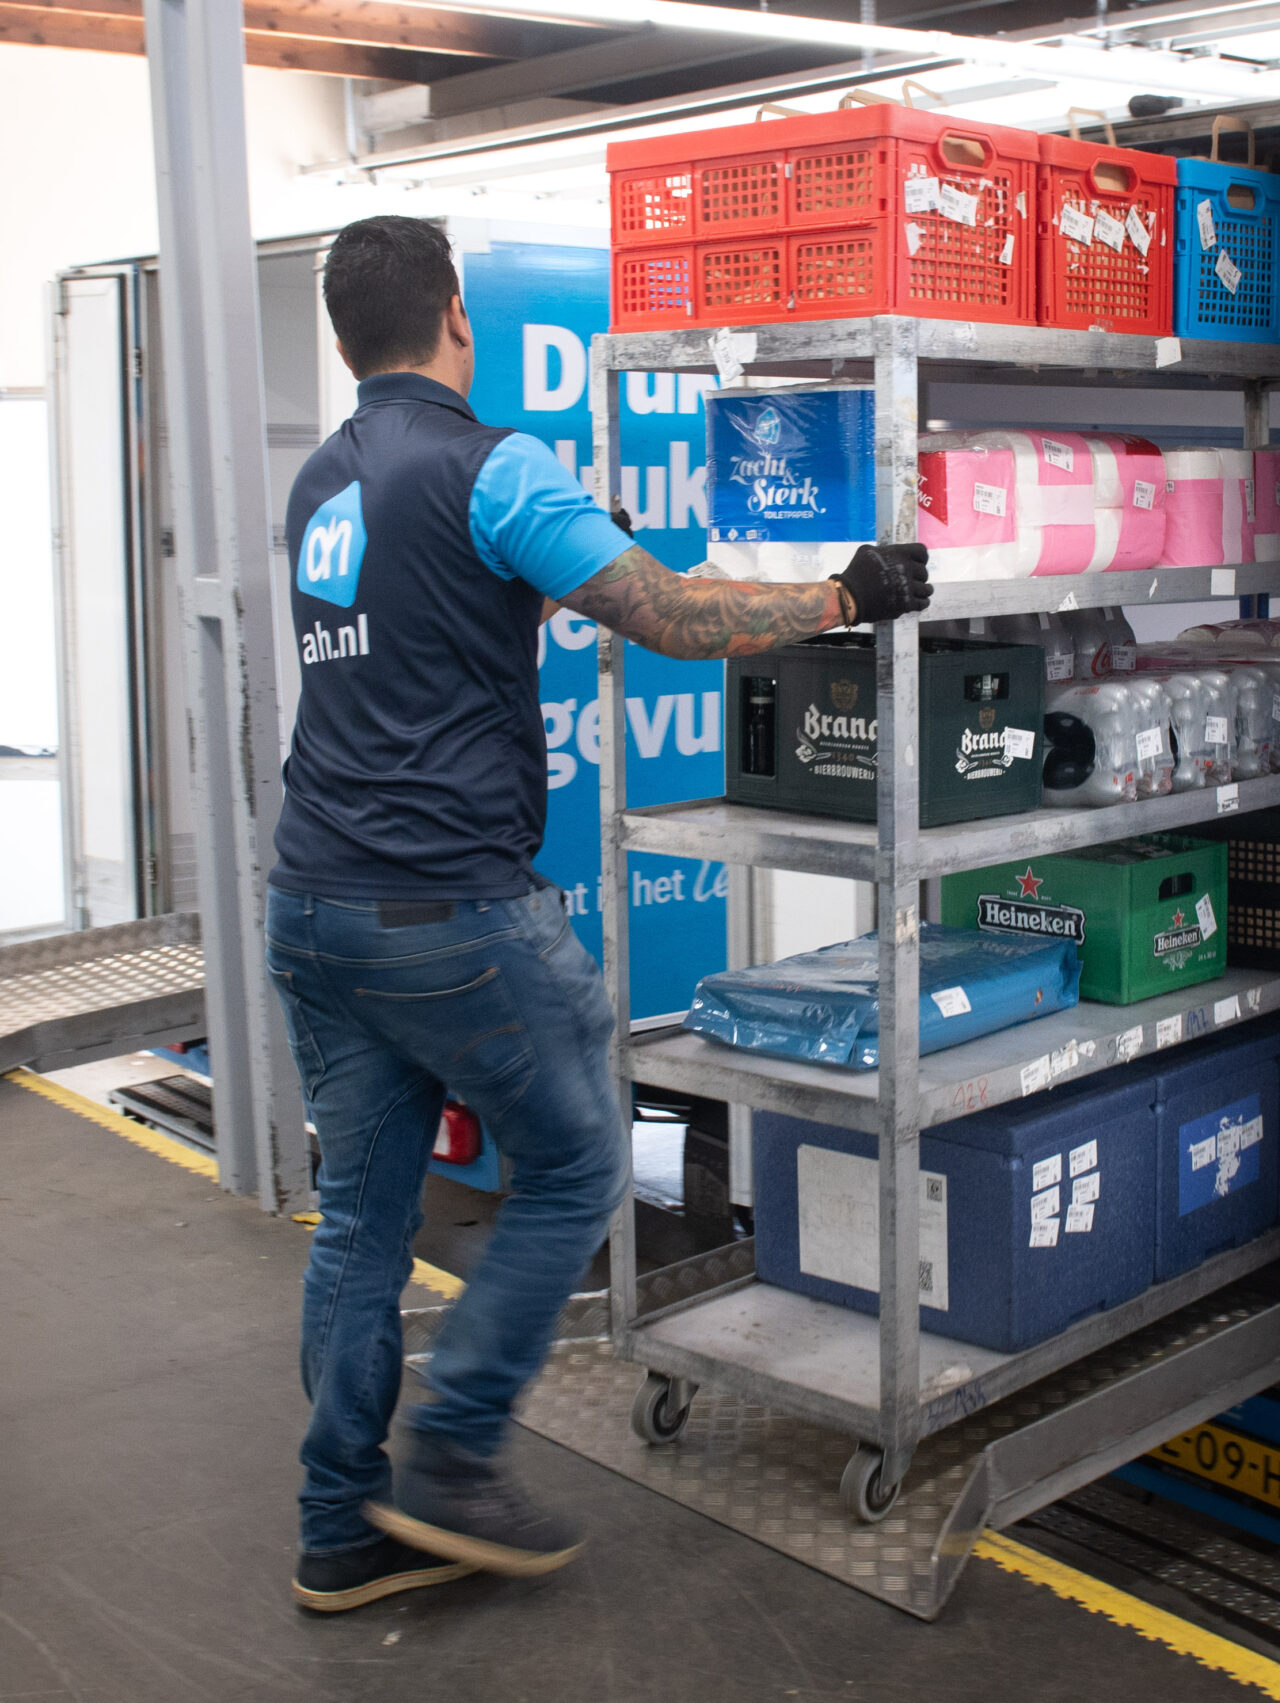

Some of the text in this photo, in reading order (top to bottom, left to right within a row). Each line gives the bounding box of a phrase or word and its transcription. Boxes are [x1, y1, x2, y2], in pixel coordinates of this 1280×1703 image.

[747, 477, 827, 513] Sterk
[763, 510, 814, 519] TOILETPAPIER
[302, 613, 370, 665] ah.nl
[814, 764, 875, 780] BIERBROUWERIJ
[632, 869, 685, 907] het
[985, 902, 1077, 936] Heineken
[1157, 931, 1198, 951] Heineken
